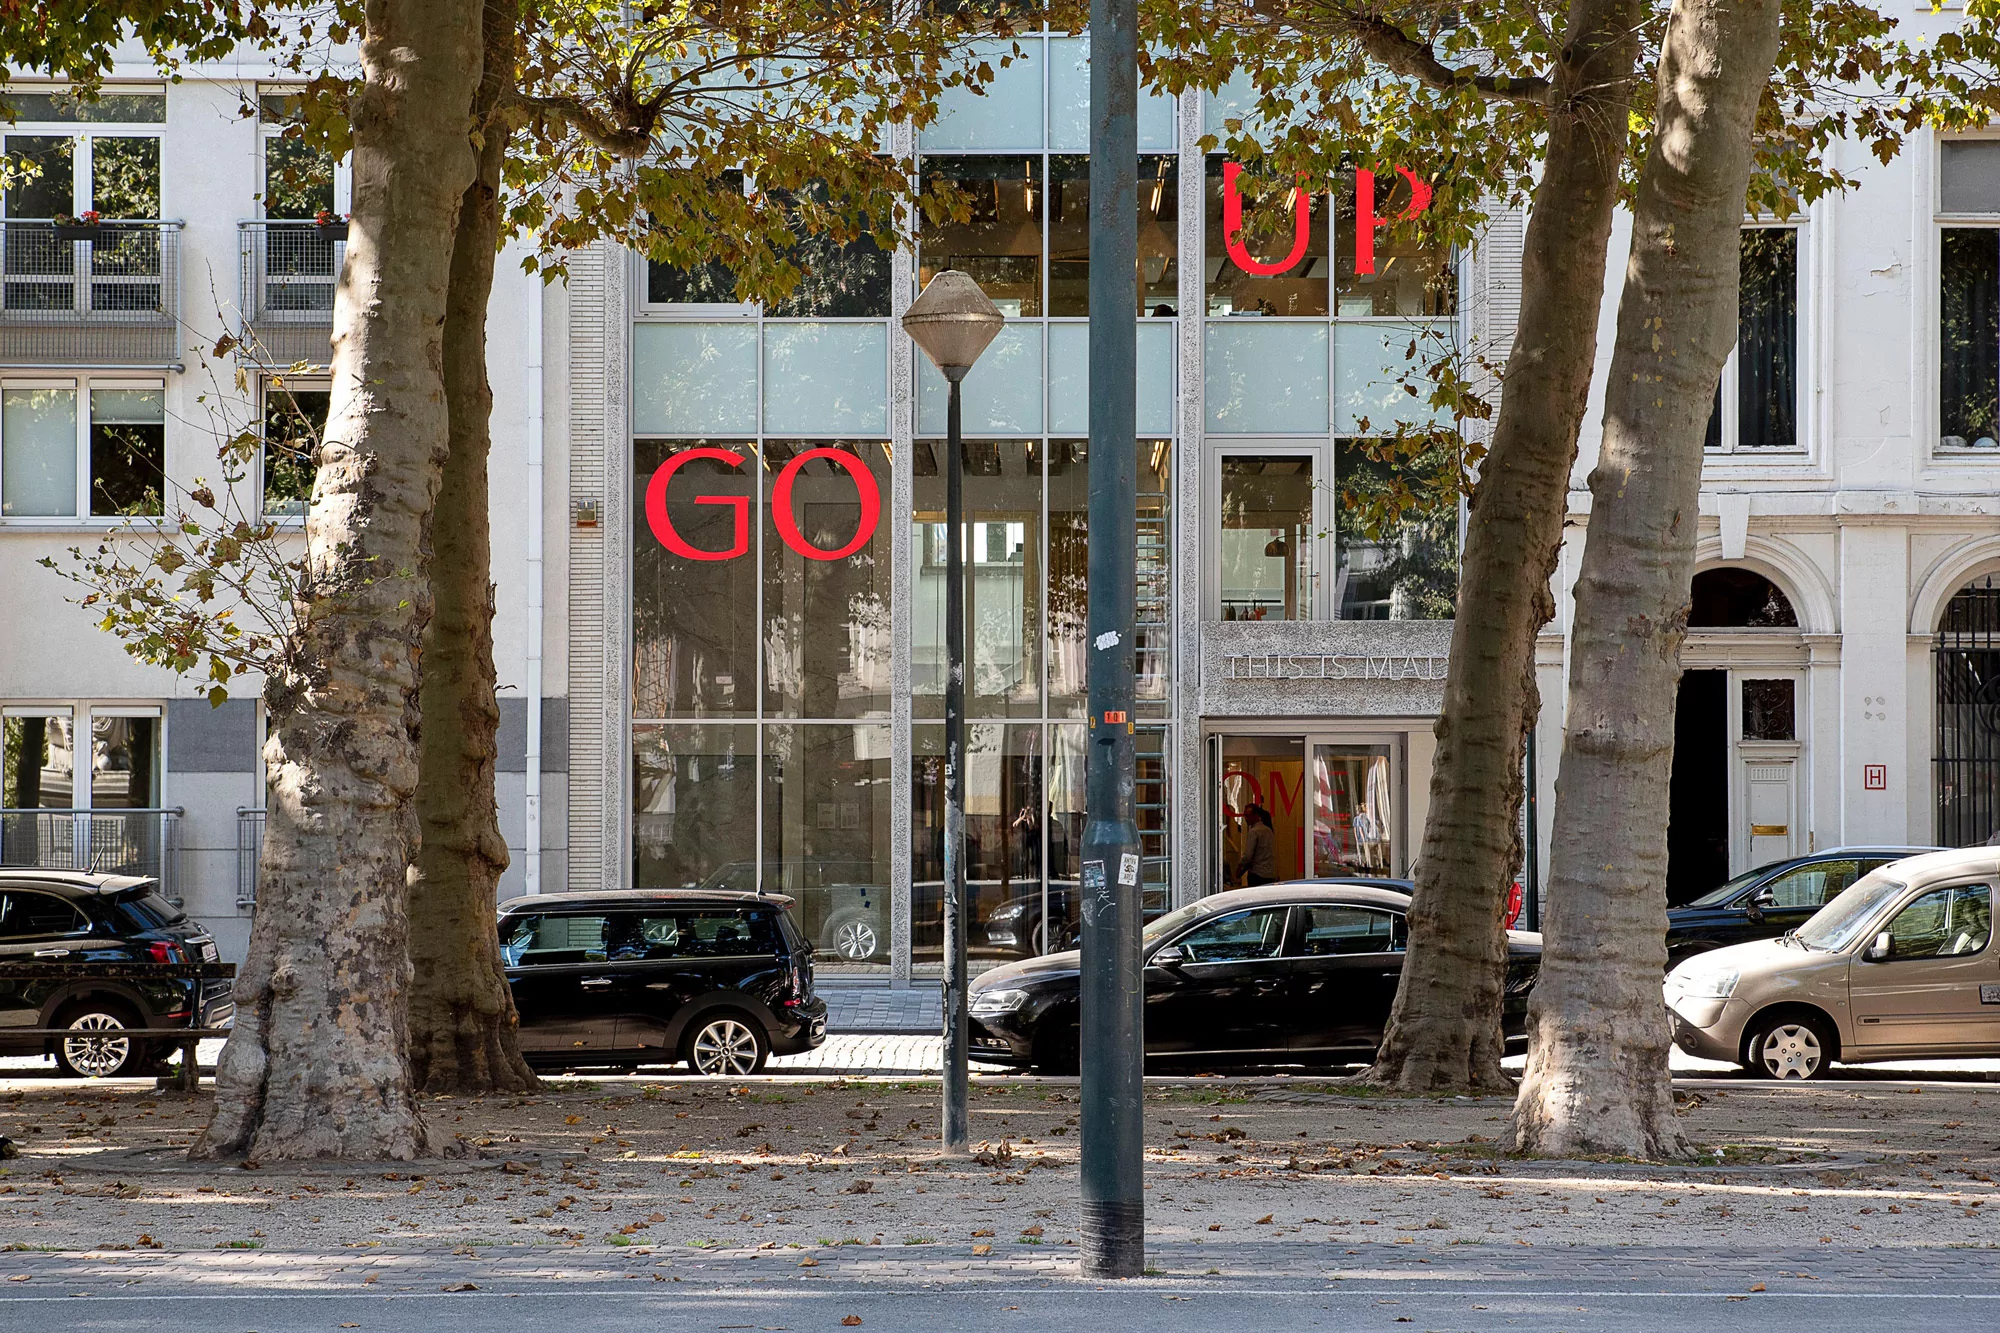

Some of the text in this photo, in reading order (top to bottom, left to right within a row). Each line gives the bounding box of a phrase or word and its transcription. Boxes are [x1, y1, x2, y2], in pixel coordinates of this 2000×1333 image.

[1223, 162, 1432, 275] UP
[645, 447, 880, 561] GO
[1224, 654, 1303, 680] THIS
[1319, 654, 1348, 680] IS
[1106, 712, 1124, 722] 101
[1870, 769, 1881, 785] H
